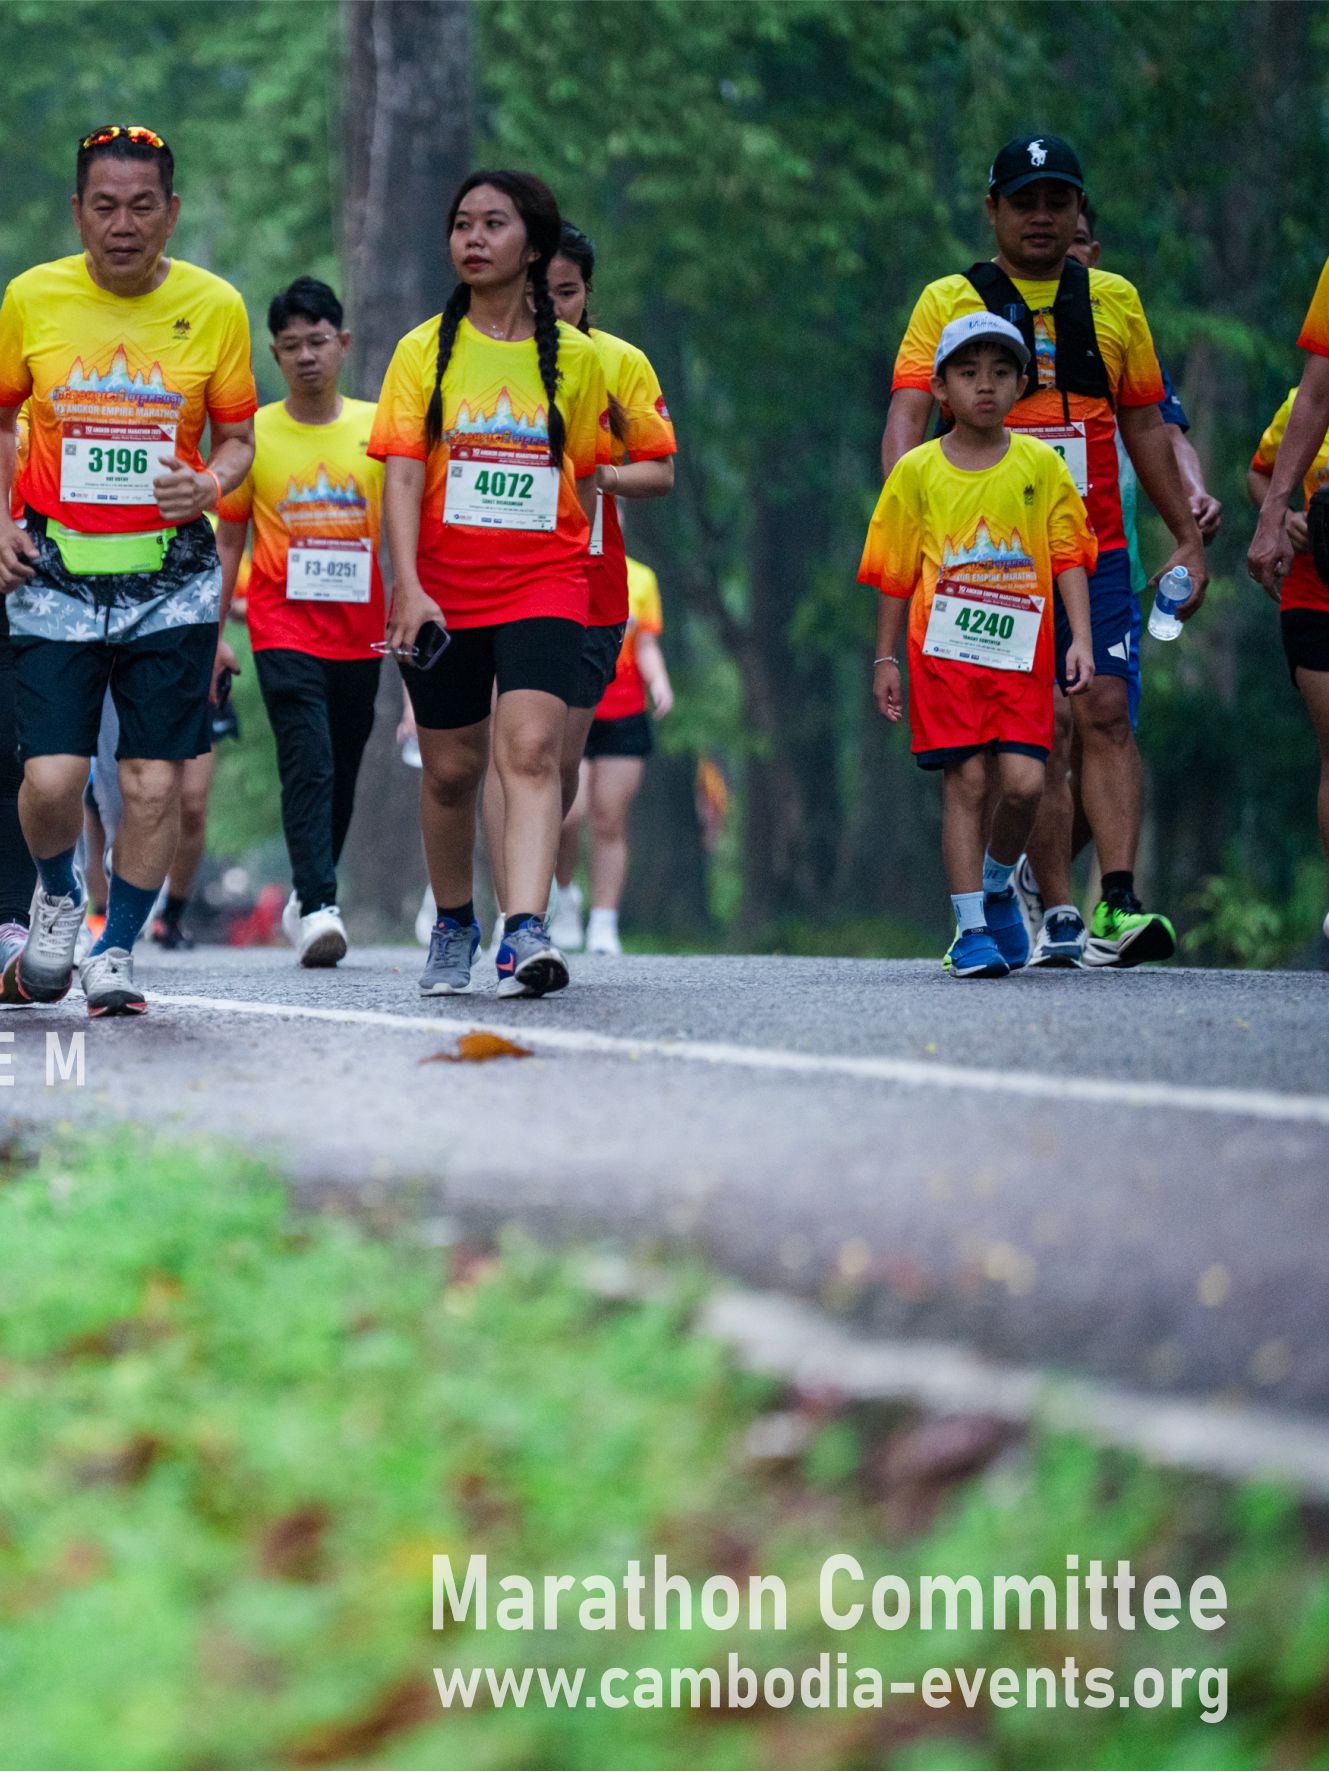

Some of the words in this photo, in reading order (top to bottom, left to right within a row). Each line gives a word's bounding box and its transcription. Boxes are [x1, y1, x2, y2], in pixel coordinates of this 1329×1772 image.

[66, 403, 100, 415] ANGKOR
[102, 405, 134, 416] EMPIRE
[88, 447, 148, 474] 3196
[474, 470, 534, 499] 4072
[305, 560, 357, 578] F3-0251
[972, 572, 1001, 581] EMPIRE
[954, 607, 1015, 640] 4240
